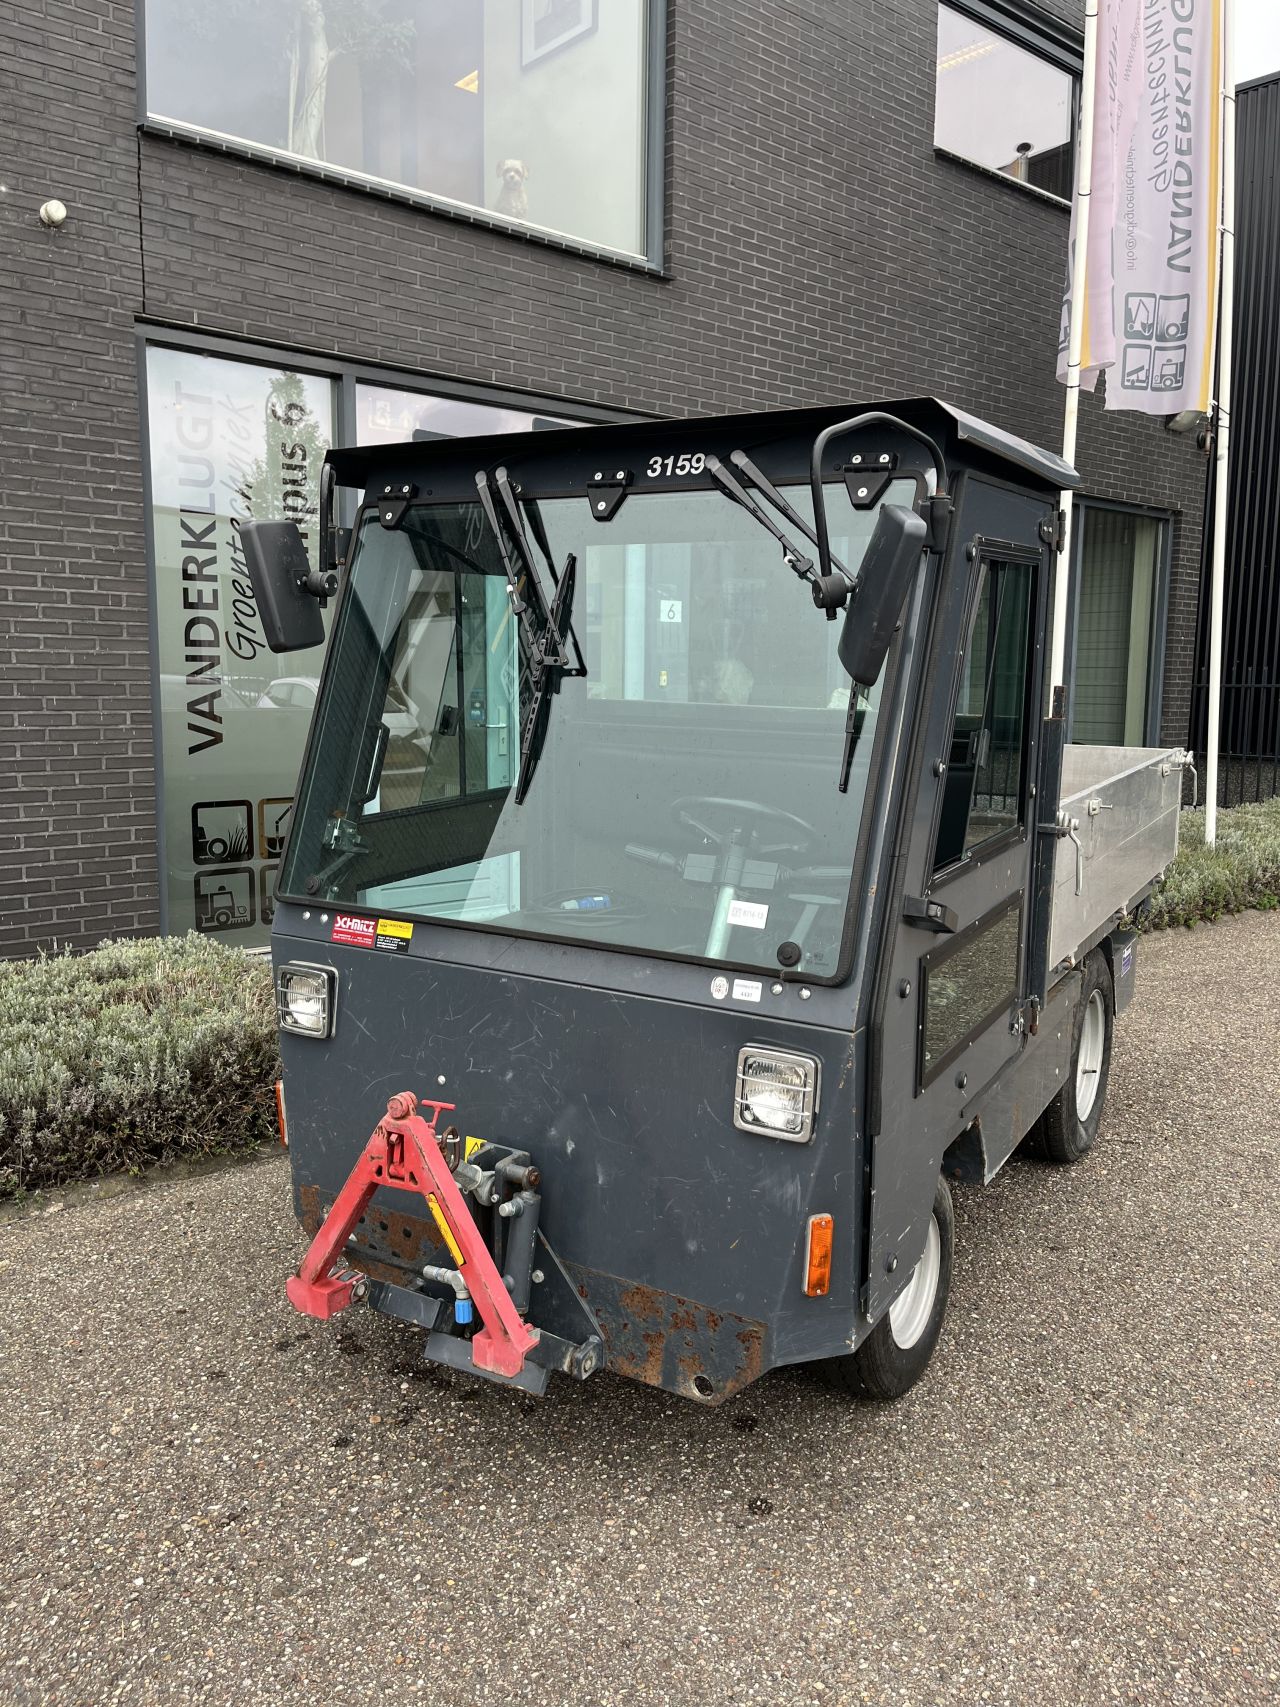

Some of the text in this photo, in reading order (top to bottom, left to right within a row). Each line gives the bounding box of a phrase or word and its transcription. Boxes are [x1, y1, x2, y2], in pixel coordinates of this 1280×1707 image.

[270, 402, 306, 426] 6
[646, 453, 706, 477] 3159
[175, 380, 223, 756] VANDERKLUGT
[667, 603, 675, 620] 6
